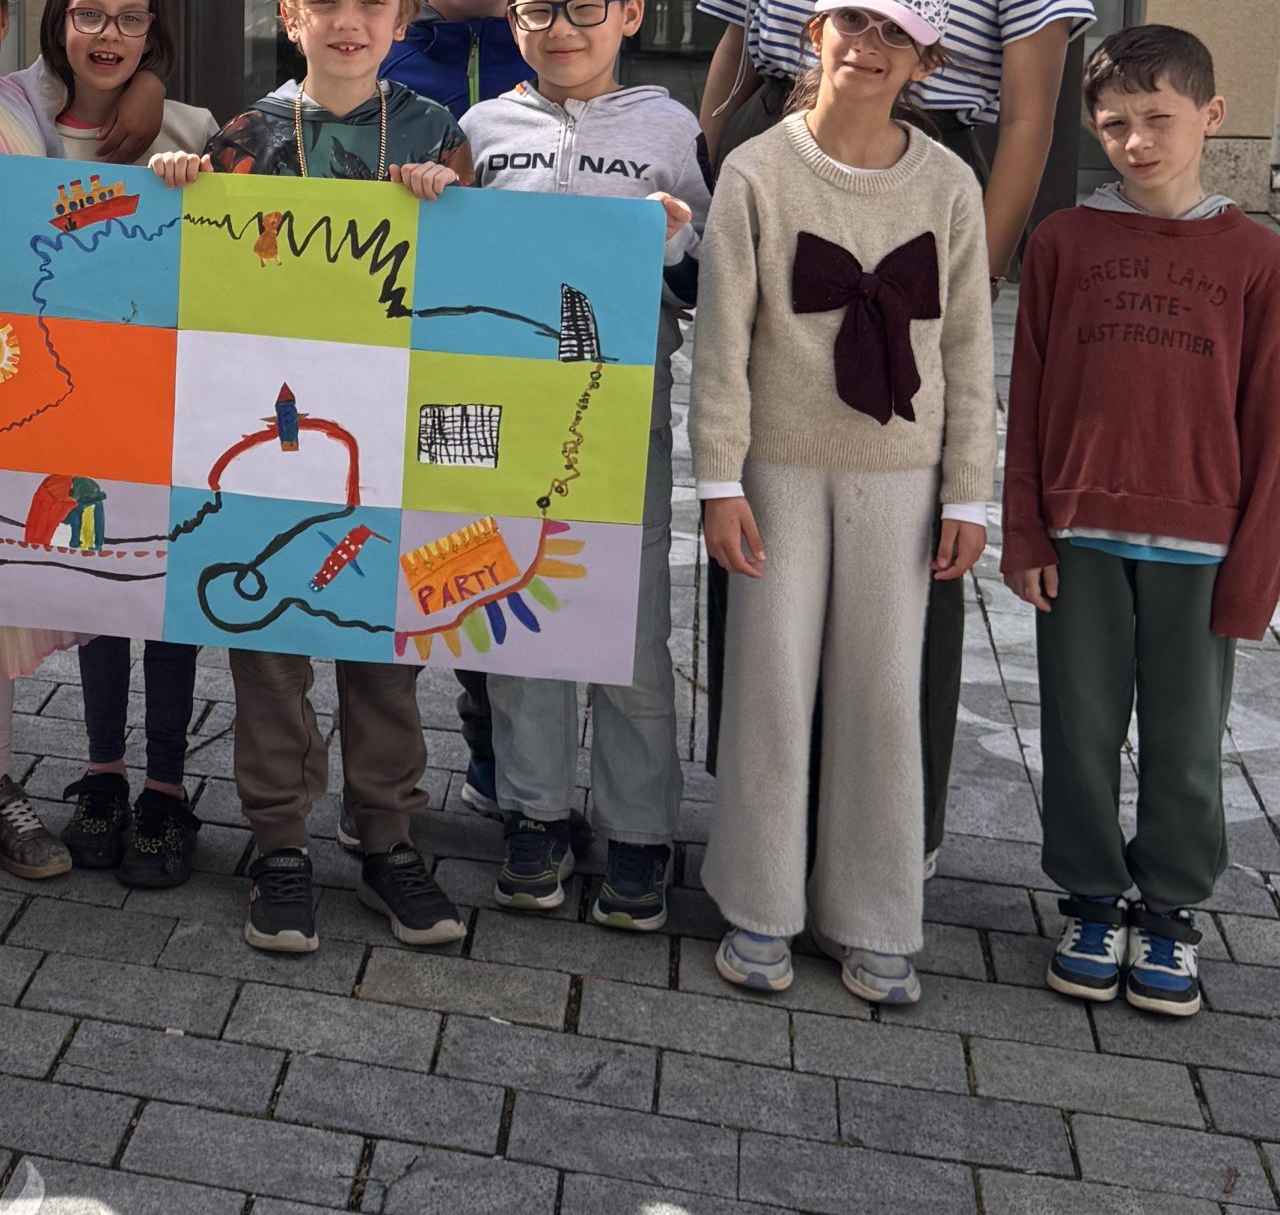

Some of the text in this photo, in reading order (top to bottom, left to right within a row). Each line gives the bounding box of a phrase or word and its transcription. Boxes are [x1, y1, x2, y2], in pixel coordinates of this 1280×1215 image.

[488, 152, 556, 171] DON
[1077, 256, 1229, 307] GREEN LAND
[1077, 322, 1215, 358] LAST FRONTIER
[417, 560, 500, 616] PARTY
